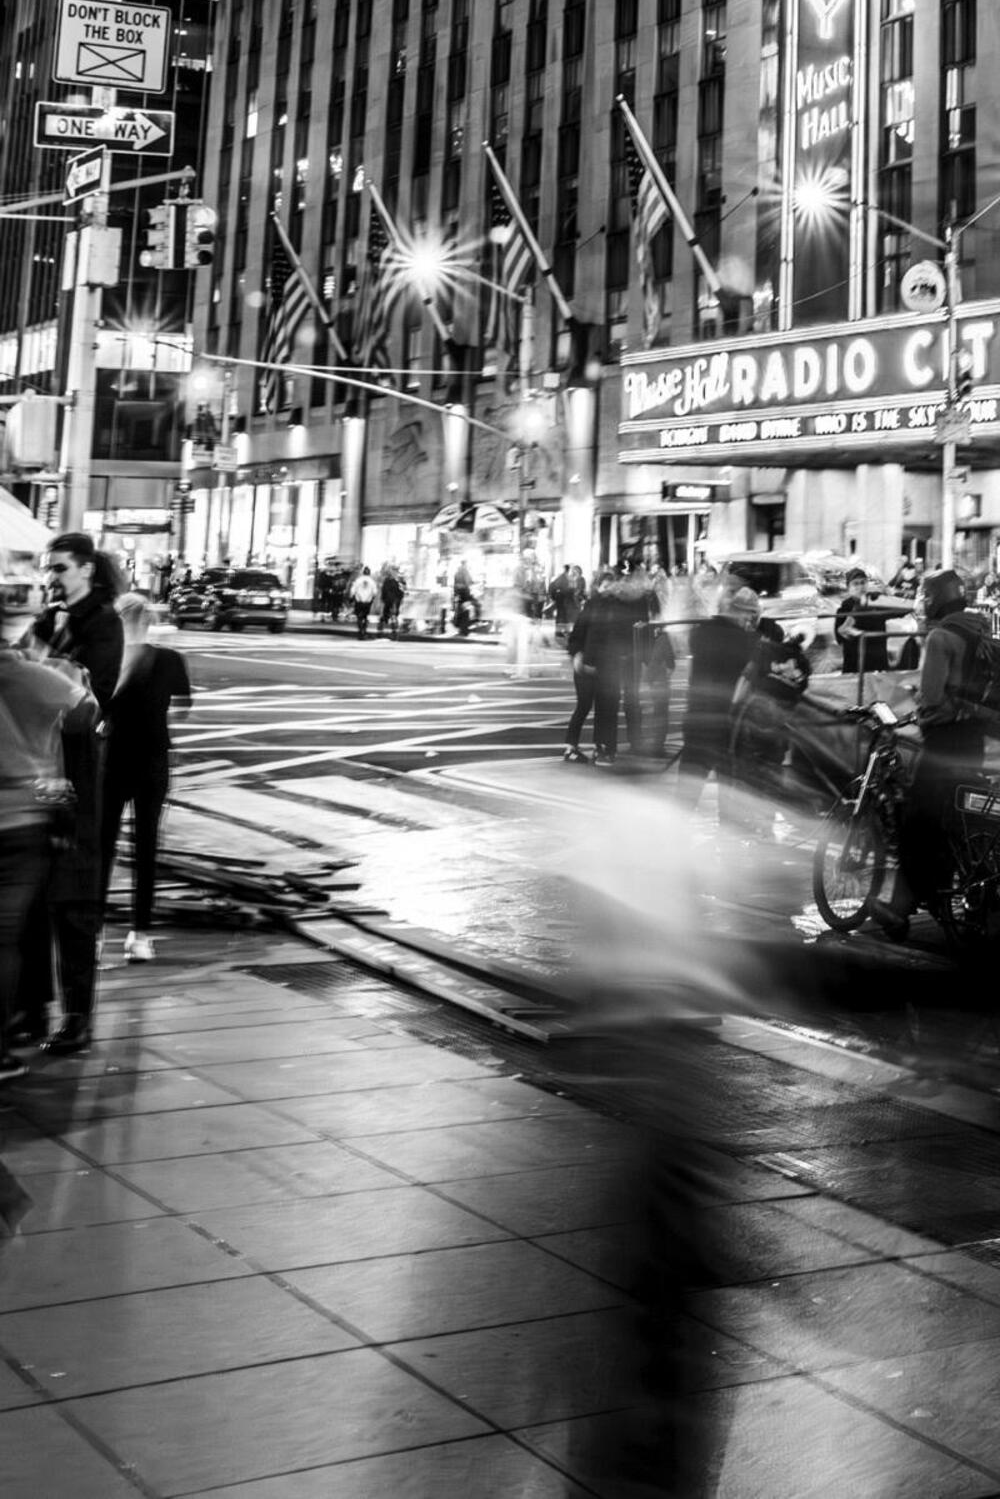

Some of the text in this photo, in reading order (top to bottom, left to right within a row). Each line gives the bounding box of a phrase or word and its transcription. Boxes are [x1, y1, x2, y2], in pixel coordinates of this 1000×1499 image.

[68, 3, 161, 28] DON'T BLOCK
[83, 24, 144, 44] THE BOX
[56, 118, 152, 140] ONE WAY
[673, 351, 730, 416] Hall
[731, 337, 877, 405] RADIO
[852, 412, 868, 431] IS
[873, 409, 900, 430] THE
